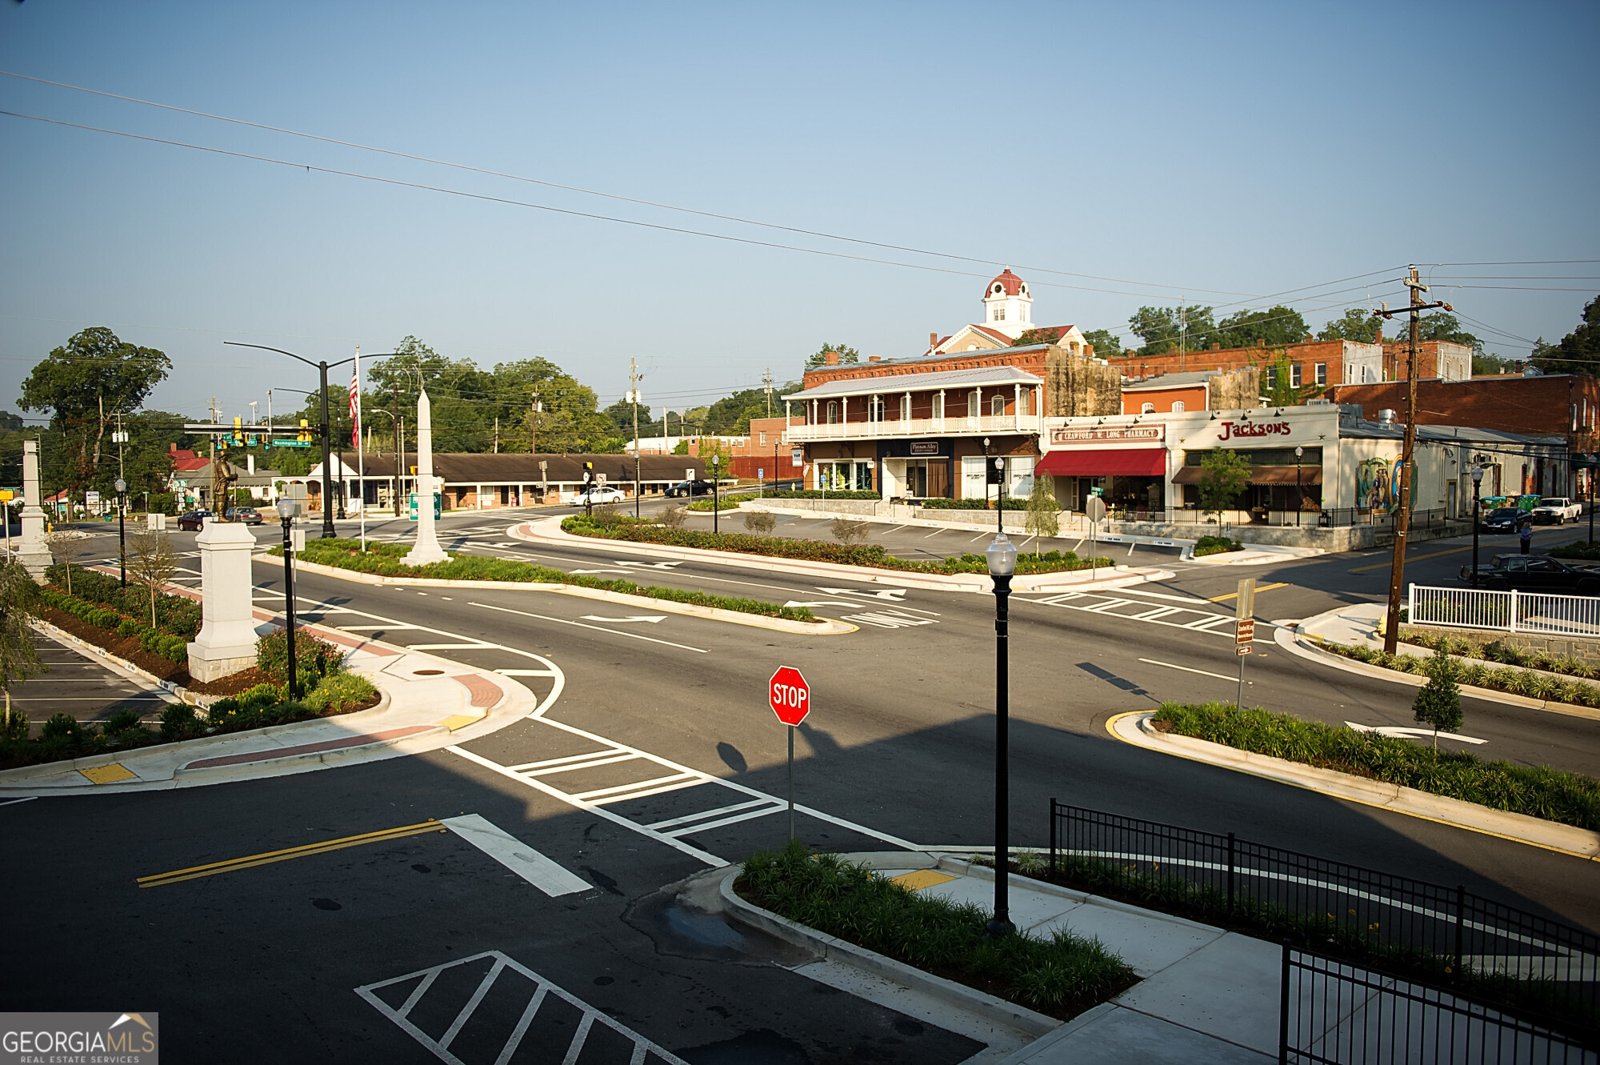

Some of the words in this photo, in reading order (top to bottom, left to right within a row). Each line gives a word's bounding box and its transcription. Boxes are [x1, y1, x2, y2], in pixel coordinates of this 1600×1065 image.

[1064, 431, 1093, 440] CRAWFORD
[1106, 430, 1120, 439] LONG
[1124, 429, 1154, 439] PHARMACY
[773, 682, 807, 709] STOP
